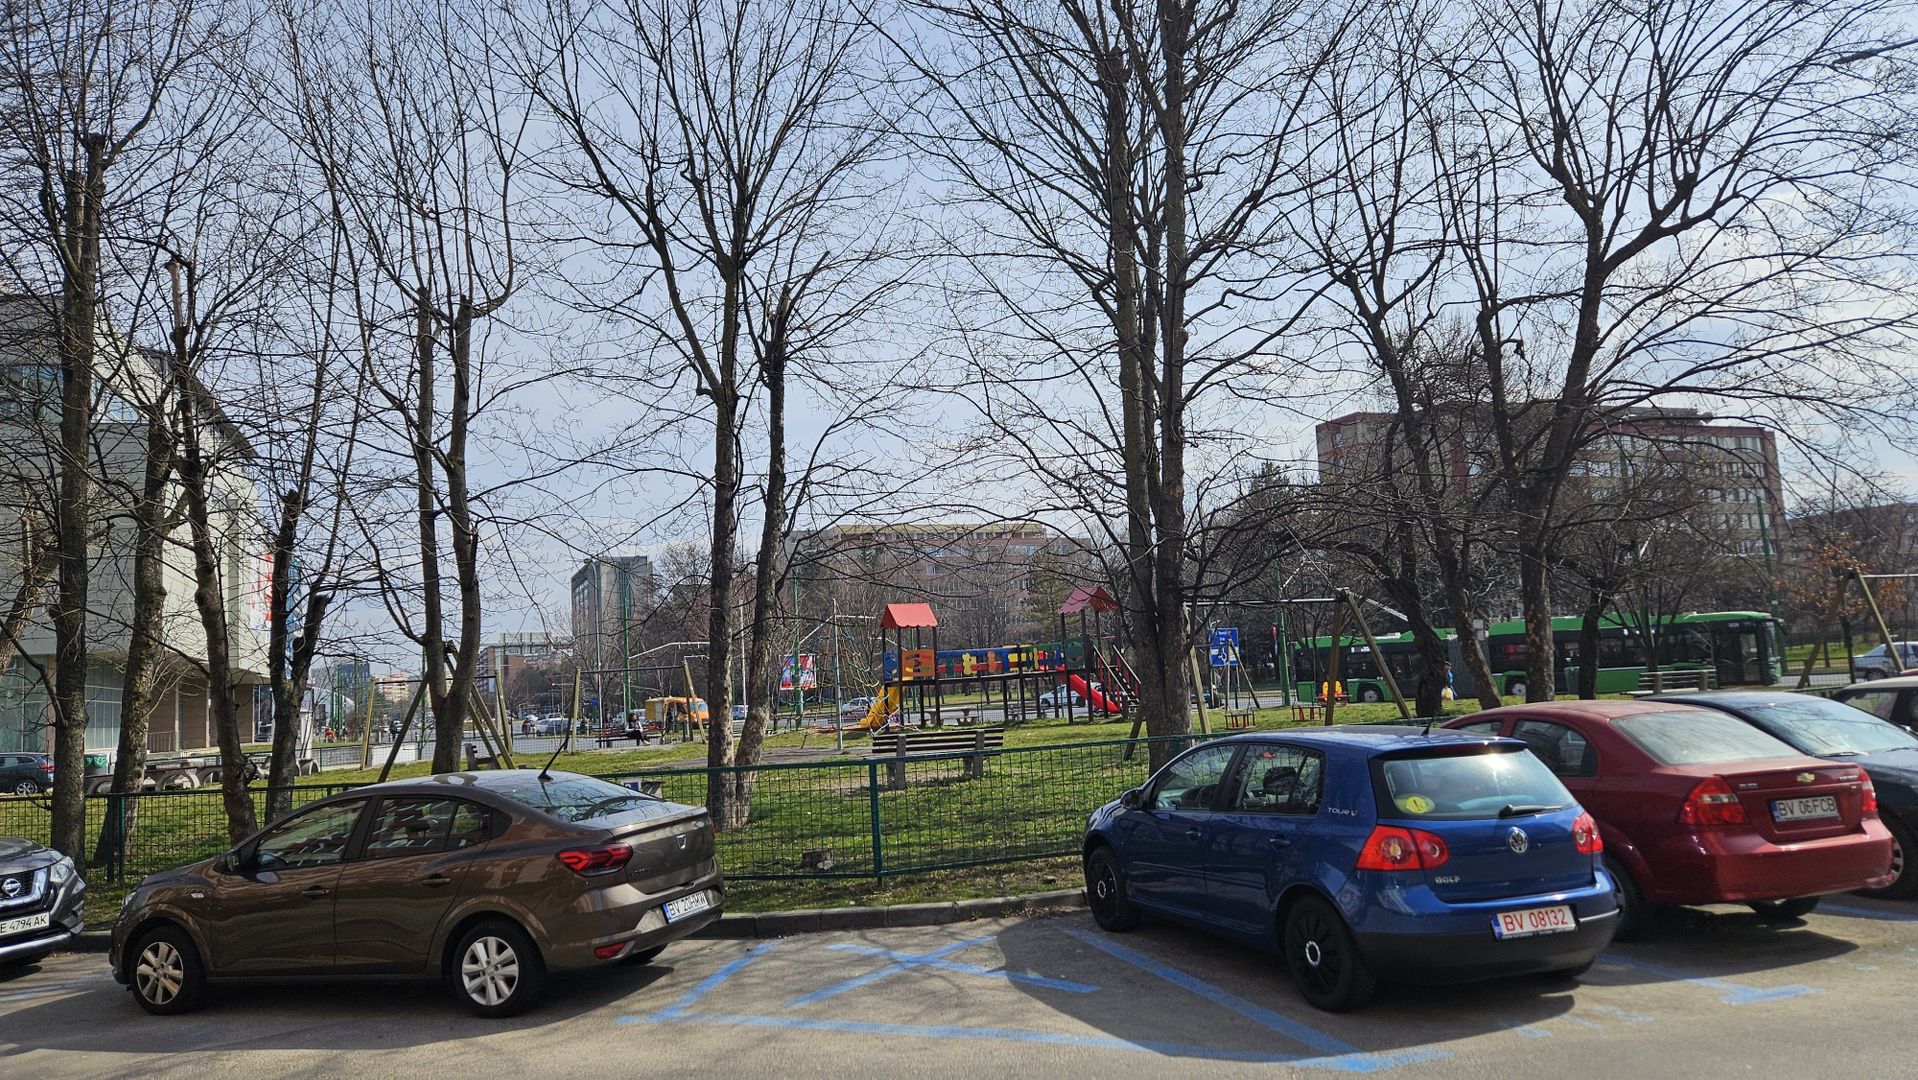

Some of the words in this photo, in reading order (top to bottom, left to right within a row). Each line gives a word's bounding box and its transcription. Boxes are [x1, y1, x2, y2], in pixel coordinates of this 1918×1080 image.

[1778, 802, 1796, 816] BV
[1800, 798, 1836, 815] 06FCB
[668, 901, 680, 915] BV
[9, 919, 32, 931] 4794
[33, 915, 47, 926] AK
[1503, 914, 1523, 932] BV
[1529, 909, 1567, 928] 08132
